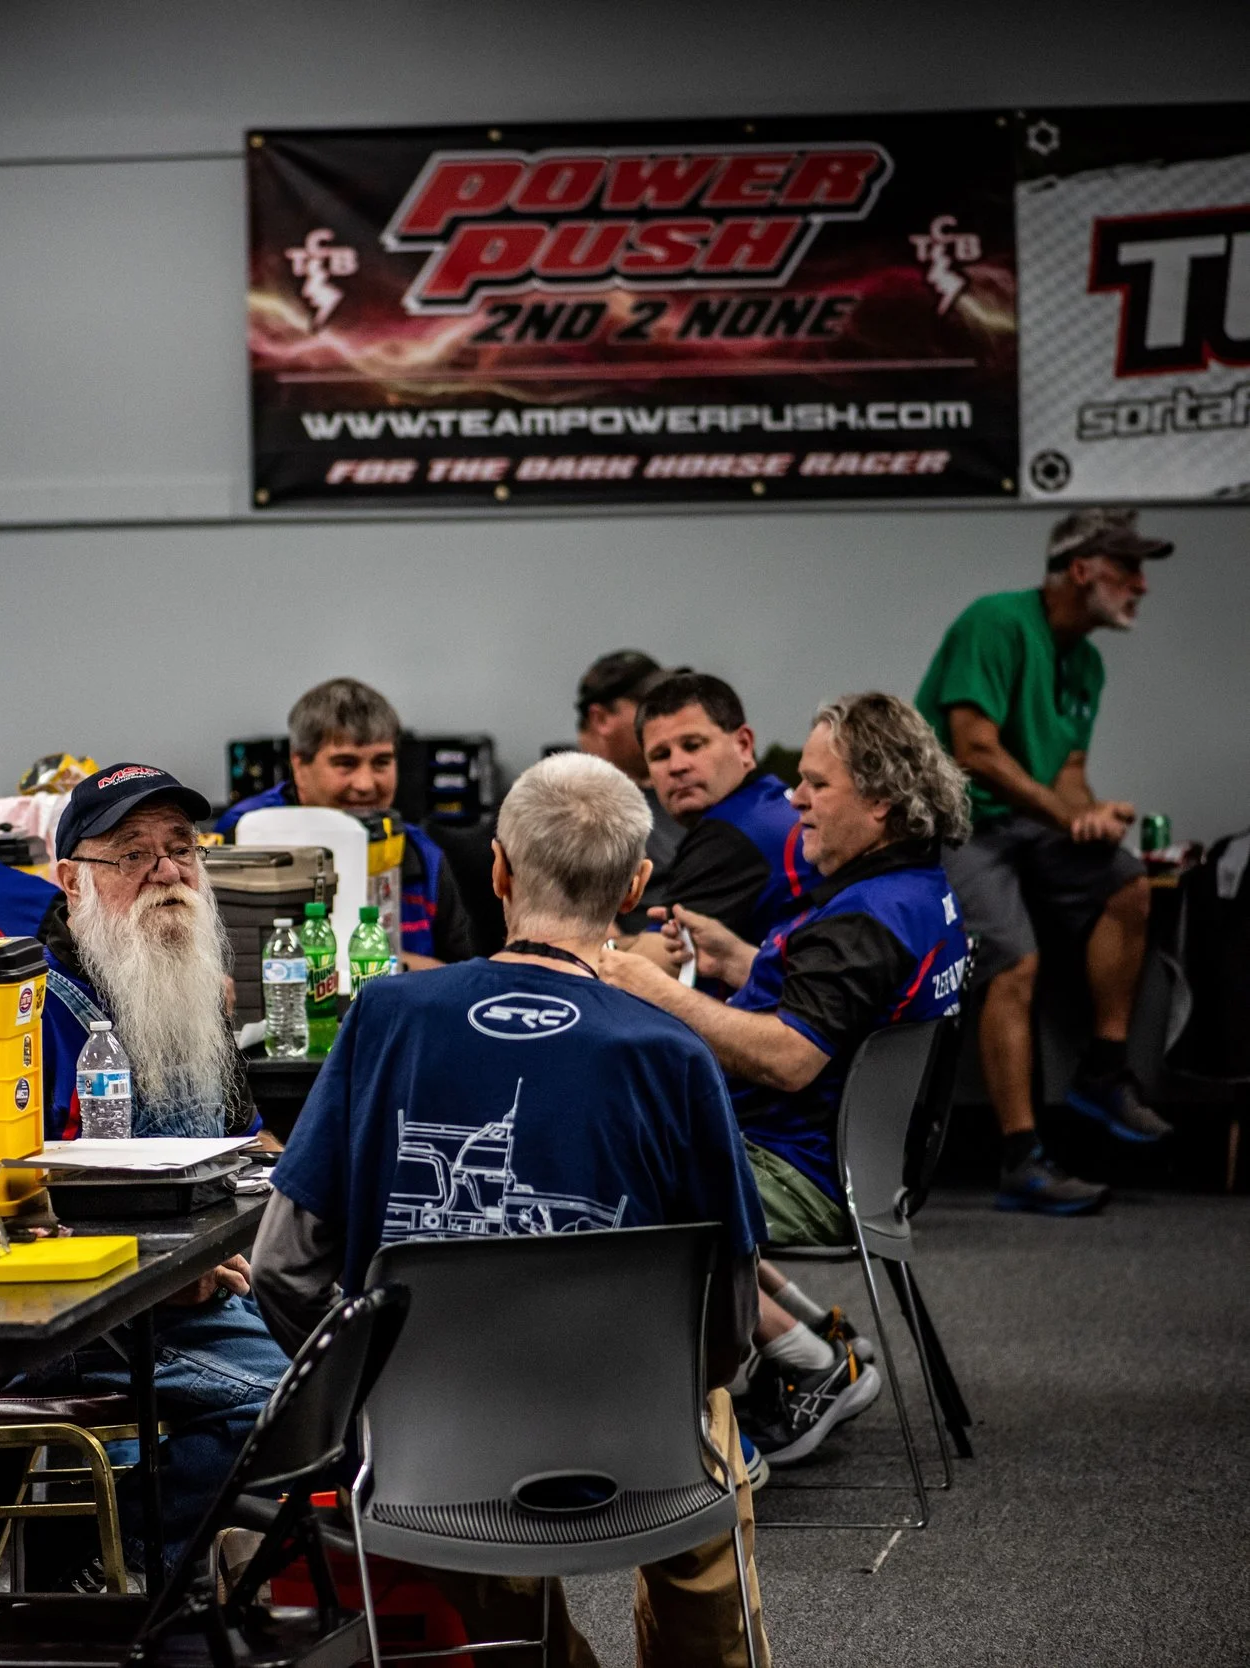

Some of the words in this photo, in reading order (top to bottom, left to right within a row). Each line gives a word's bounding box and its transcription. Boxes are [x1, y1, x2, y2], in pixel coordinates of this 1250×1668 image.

[398, 152, 880, 236] POWER
[422, 217, 804, 299] PUSH
[474, 302, 606, 345] 2ND
[614, 298, 670, 342] 2
[676, 295, 860, 342] NONE
[326, 458, 418, 485] FOR
[426, 456, 510, 483] THE
[514, 455, 638, 481] DARK
[643, 453, 796, 479] HORSE
[799, 449, 950, 475] RACER
